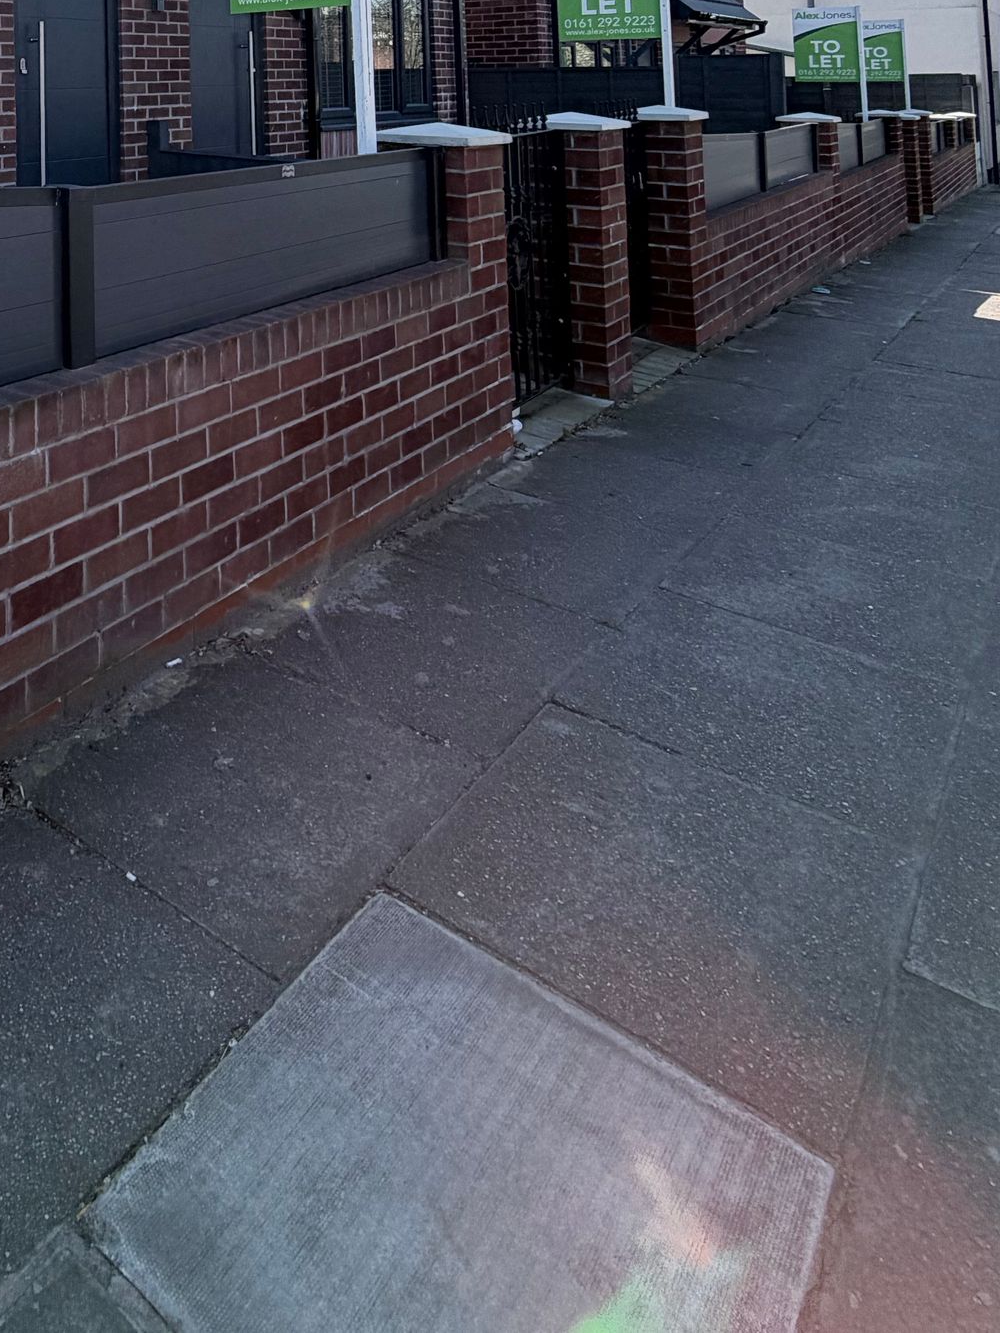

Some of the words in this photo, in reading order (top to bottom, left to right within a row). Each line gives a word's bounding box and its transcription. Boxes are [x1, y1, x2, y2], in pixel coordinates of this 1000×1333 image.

[564, 18, 592, 29] 0161
[597, 17, 621, 27] 292
[624, 15, 656, 27] 9223
[565, 26, 655, 36] www.alex-jones.co.uk
[810, 39, 841, 54] TO
[864, 46, 888, 58] TO
[808, 54, 846, 68] LET
